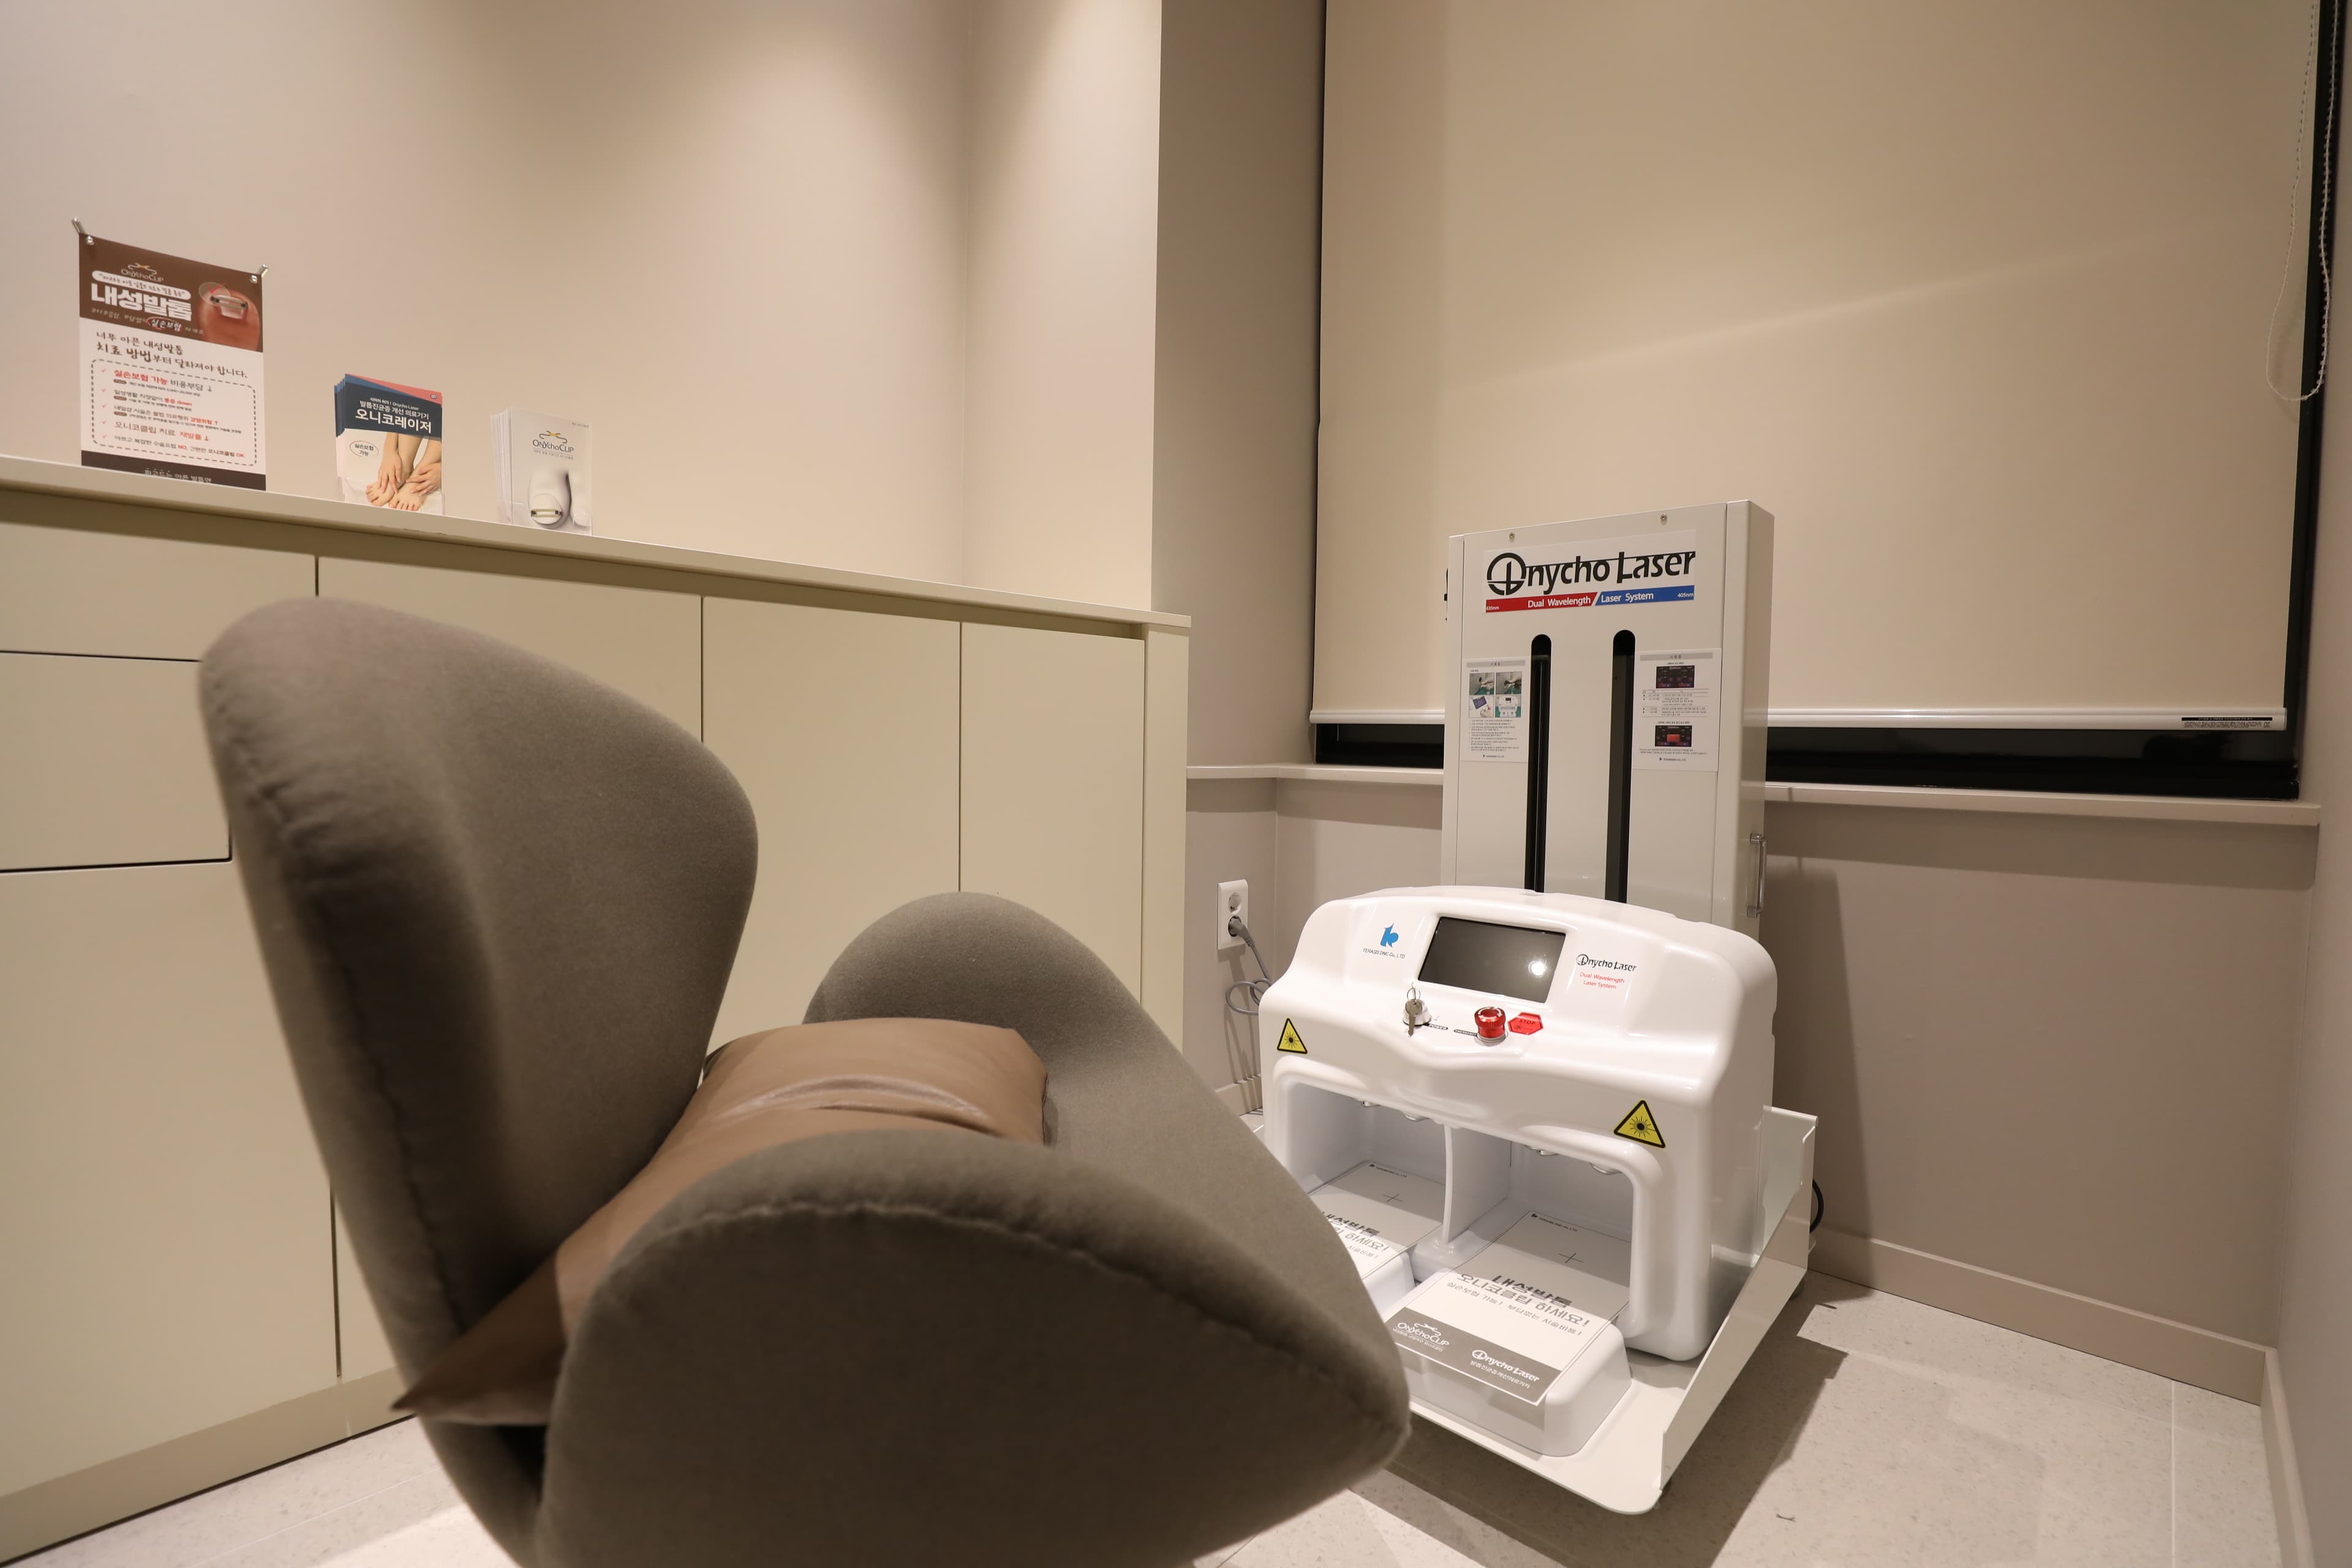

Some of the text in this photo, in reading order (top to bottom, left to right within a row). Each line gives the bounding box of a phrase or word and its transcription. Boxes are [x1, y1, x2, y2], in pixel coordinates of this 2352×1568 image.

[91, 283, 192, 321] 내성발톱
[151, 318, 181, 332] 실손보험
[97, 331, 183, 356] 너무 아픈 내성발톱
[97, 342, 247, 378] 치료 방법부터 달라져야 합니다.
[114, 369, 149, 382] 실손보험
[151, 376, 168, 385] 가능
[170, 379, 204, 391] 비용부담
[360, 400, 429, 420] 발톱진균증 개선 의료기기
[115, 421, 157, 434] 오니코클립
[355, 409, 431, 434] 오니코레이저
[355, 443, 374, 451] 실손보험
[1487, 551, 1696, 595] Onycho Laser
[1528, 599, 1544, 608] Dual
[1548, 596, 1591, 607] Wavelength
[1601, 595, 1622, 603] Laser
[1625, 592, 1654, 603] System
[1576, 954, 1637, 971] Onycho Laser
[1593, 973, 1625, 984] Wavelength
[1597, 981, 1617, 990] System
[1457, 1273, 1591, 1327] 오니코클립 하세요!
[1491, 1275, 1572, 1308] 내성발톱
[1513, 1367, 1540, 1382] Laser
